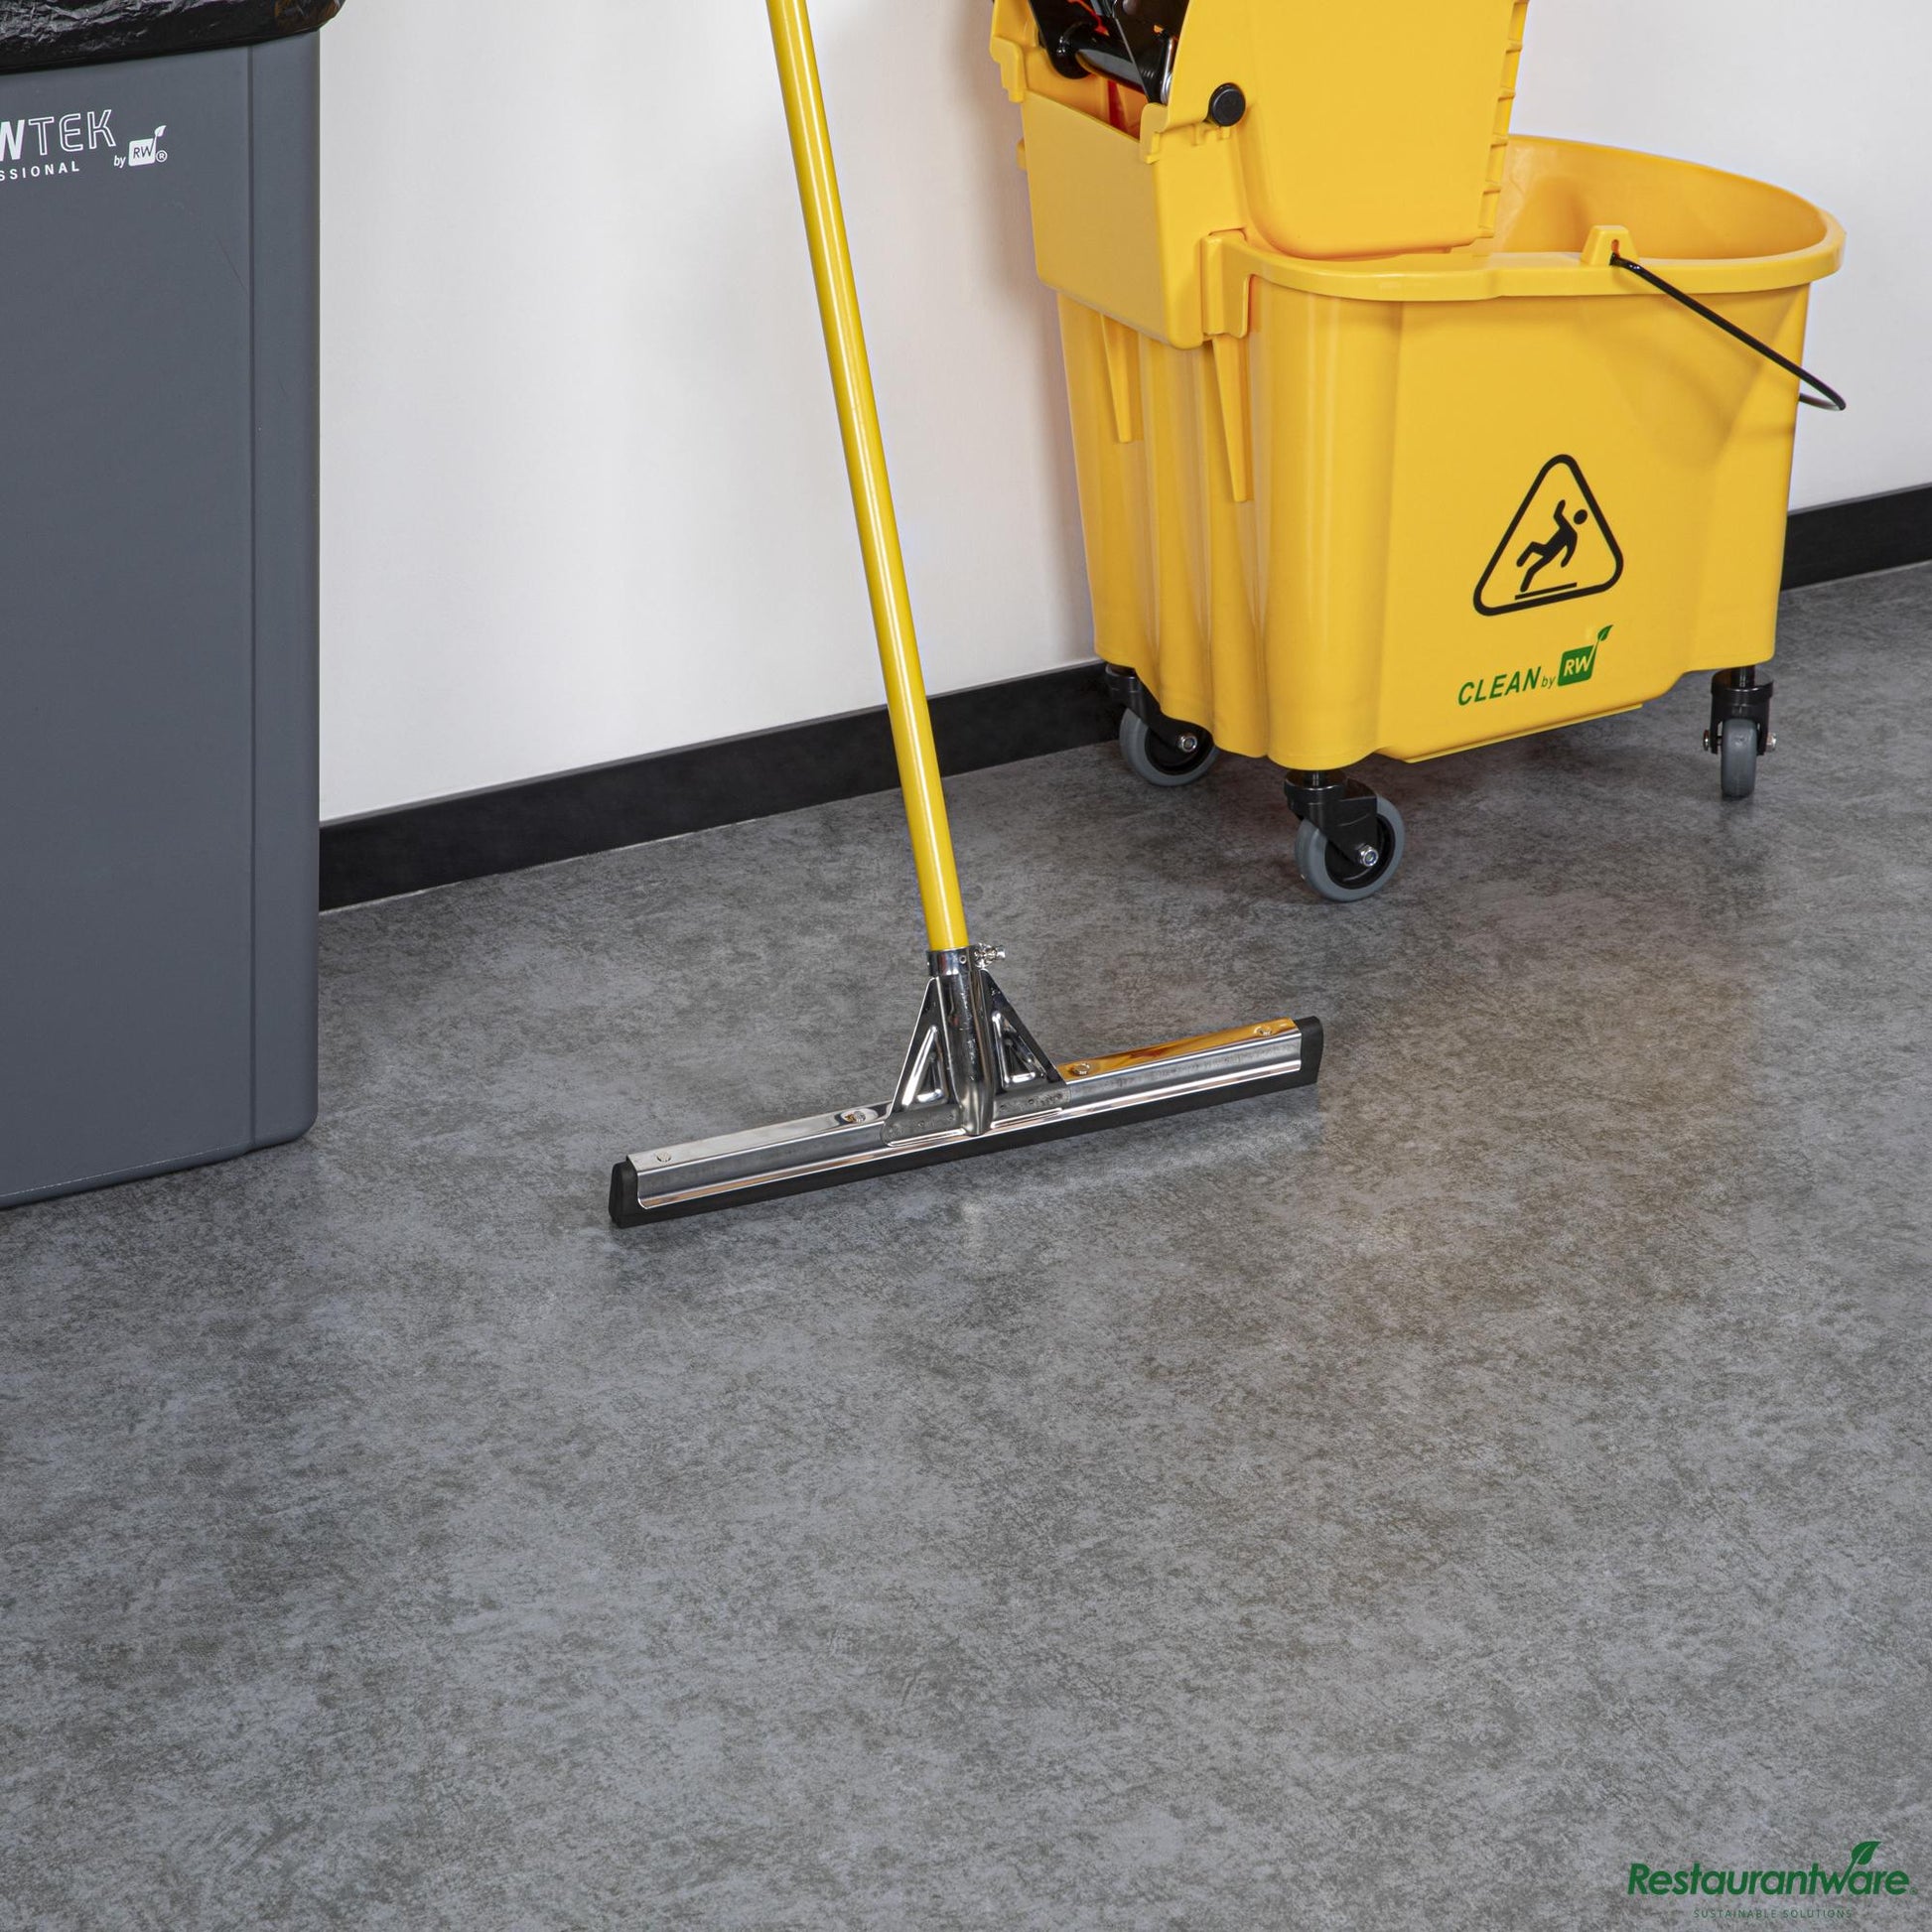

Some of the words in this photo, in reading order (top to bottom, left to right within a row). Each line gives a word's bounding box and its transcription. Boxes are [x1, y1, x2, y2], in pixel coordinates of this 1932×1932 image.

[0, 161, 80, 182] SSIONAL
[113, 155, 126, 168] by
[1457, 666, 1542, 706] CLEAN
[1541, 676, 1556, 689] by
